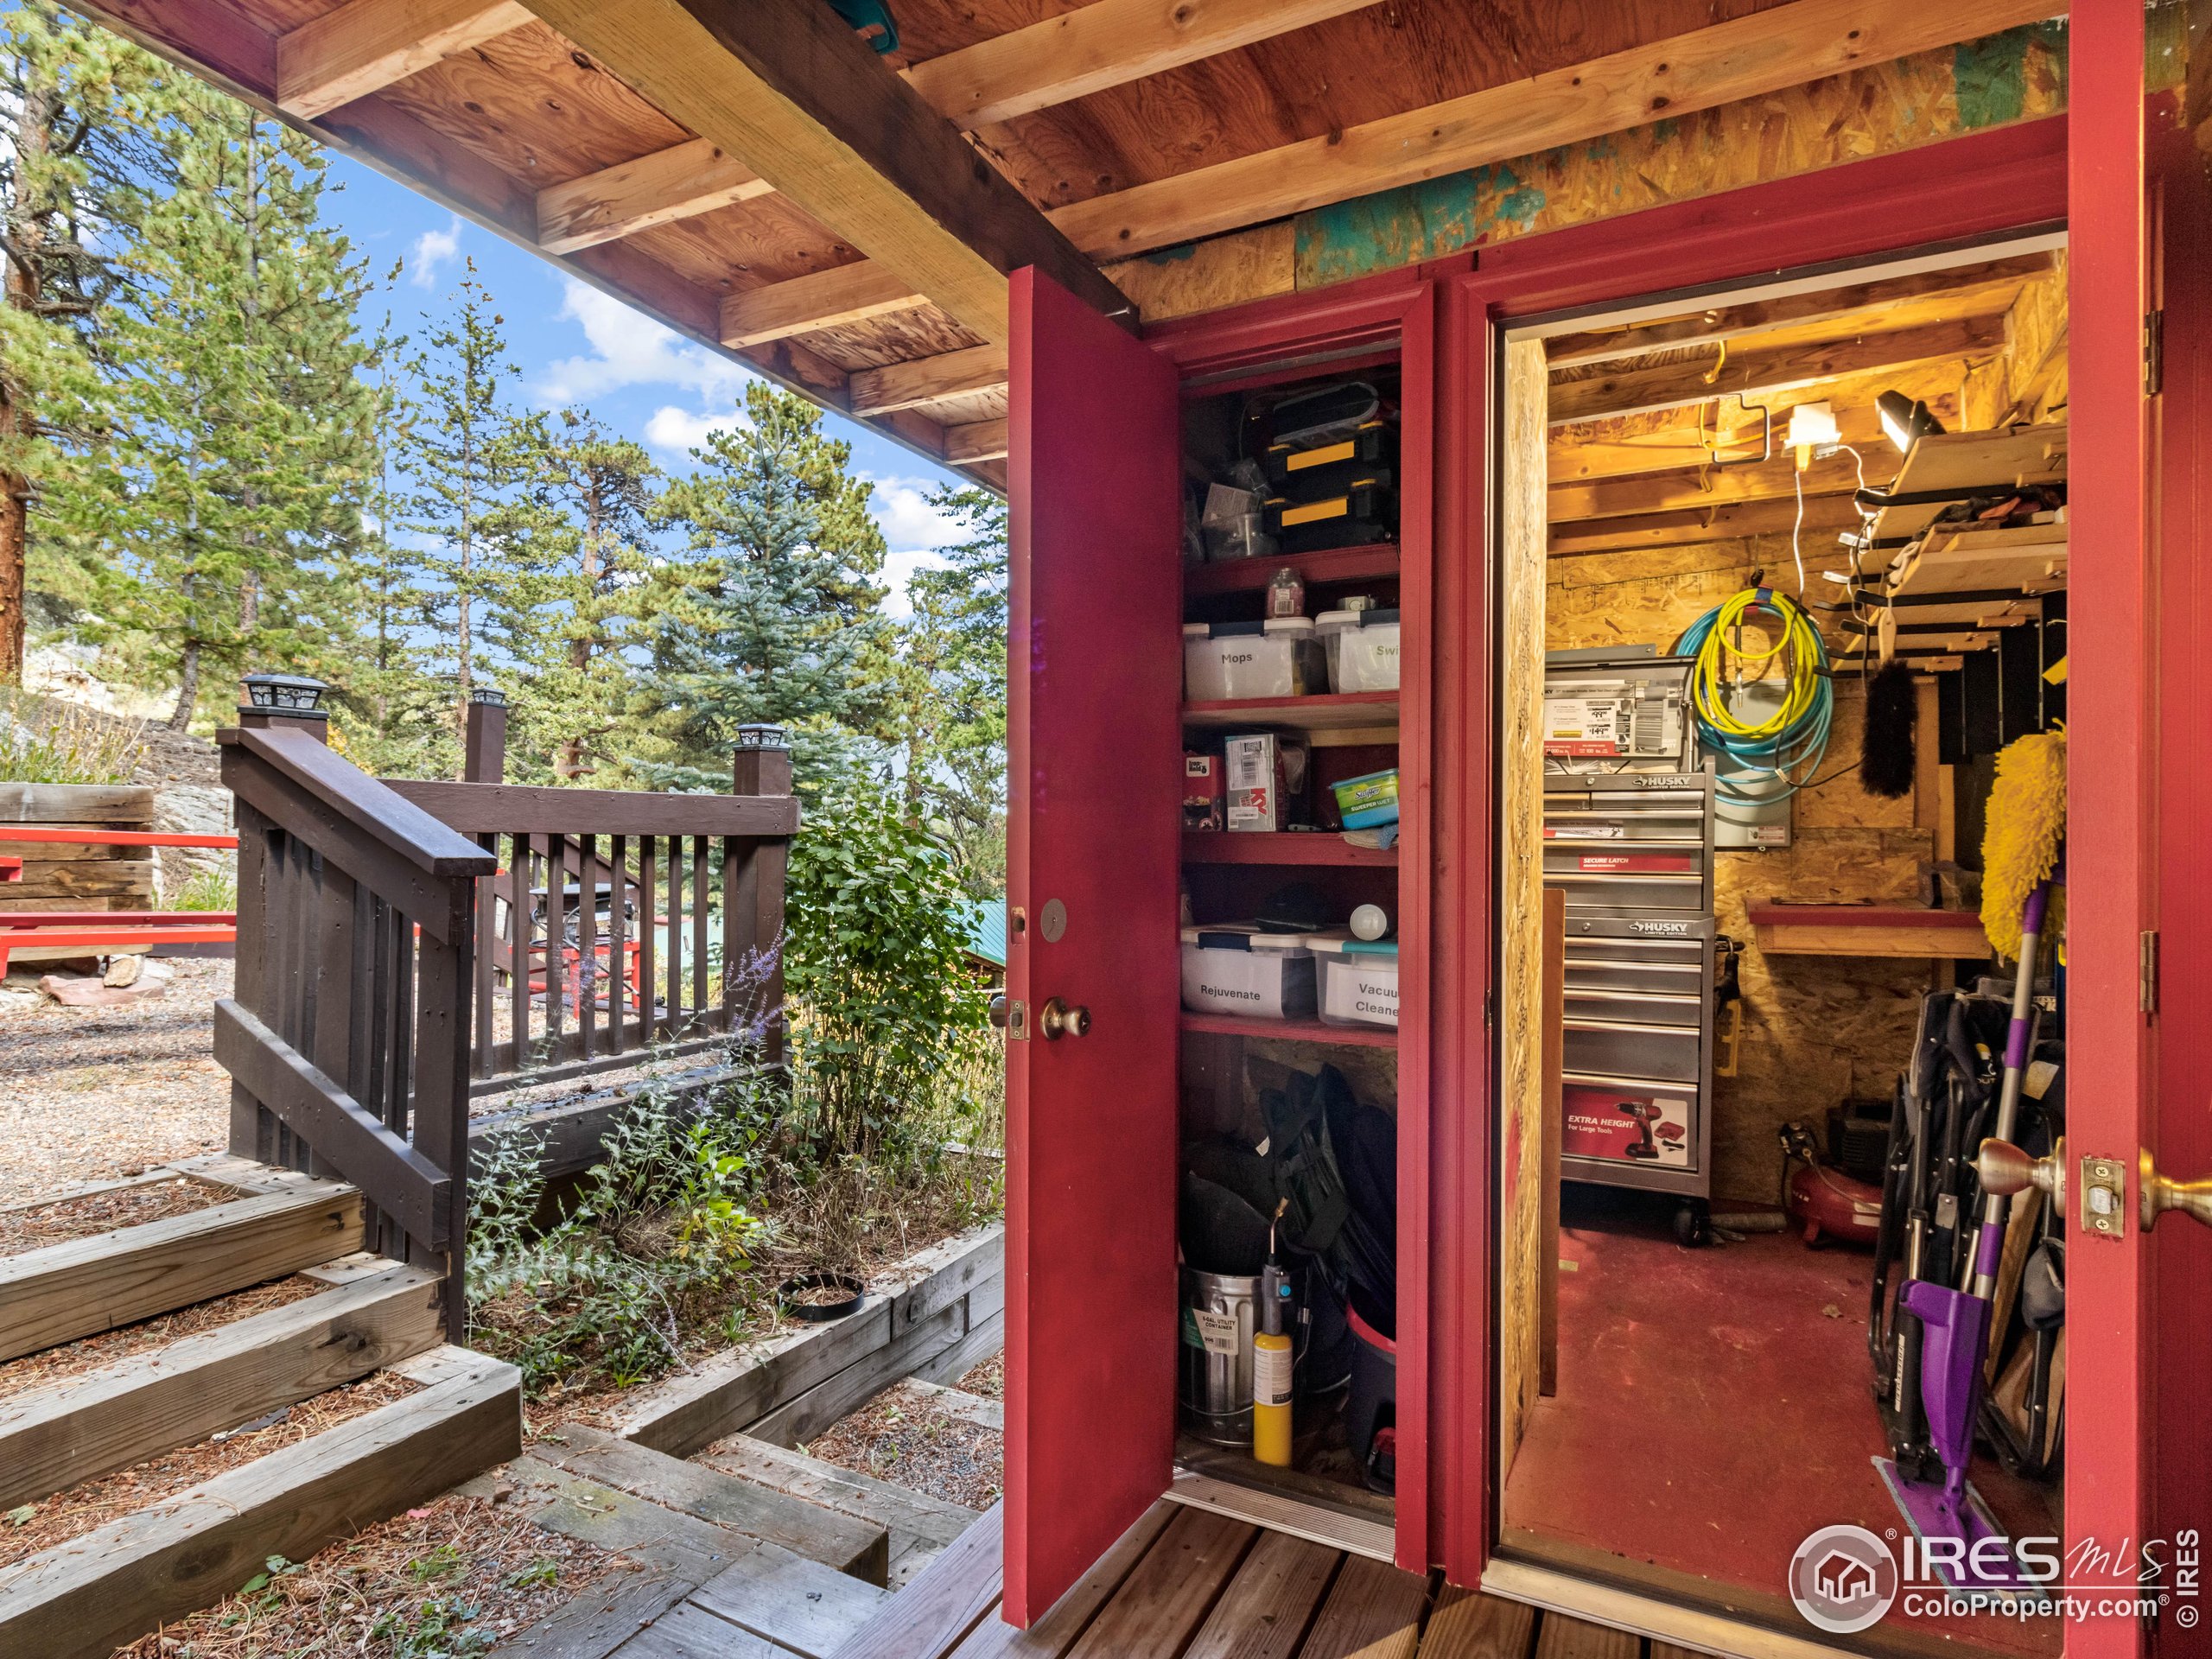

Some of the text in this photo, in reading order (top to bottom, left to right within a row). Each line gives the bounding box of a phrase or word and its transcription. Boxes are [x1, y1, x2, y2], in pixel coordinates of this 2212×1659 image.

[1376, 645, 1399, 656] Swi
[1222, 653, 1253, 664] Mops
[1648, 776, 1692, 785] HUSKY
[1355, 787, 1382, 800] Swiffer
[1351, 800, 1377, 812] SWEEPER
[1644, 922, 1688, 931] HUSKY
[1200, 984, 1261, 1001] Rejuvenate
[1359, 983, 1399, 998] Vacuu
[1356, 1001, 1399, 1017] Cleane
[1568, 1115, 1635, 1128] EXTRA HEIGHT
[1579, 1125, 1596, 1134] Large
[1205, 1322, 1232, 1331] CONTAINER
